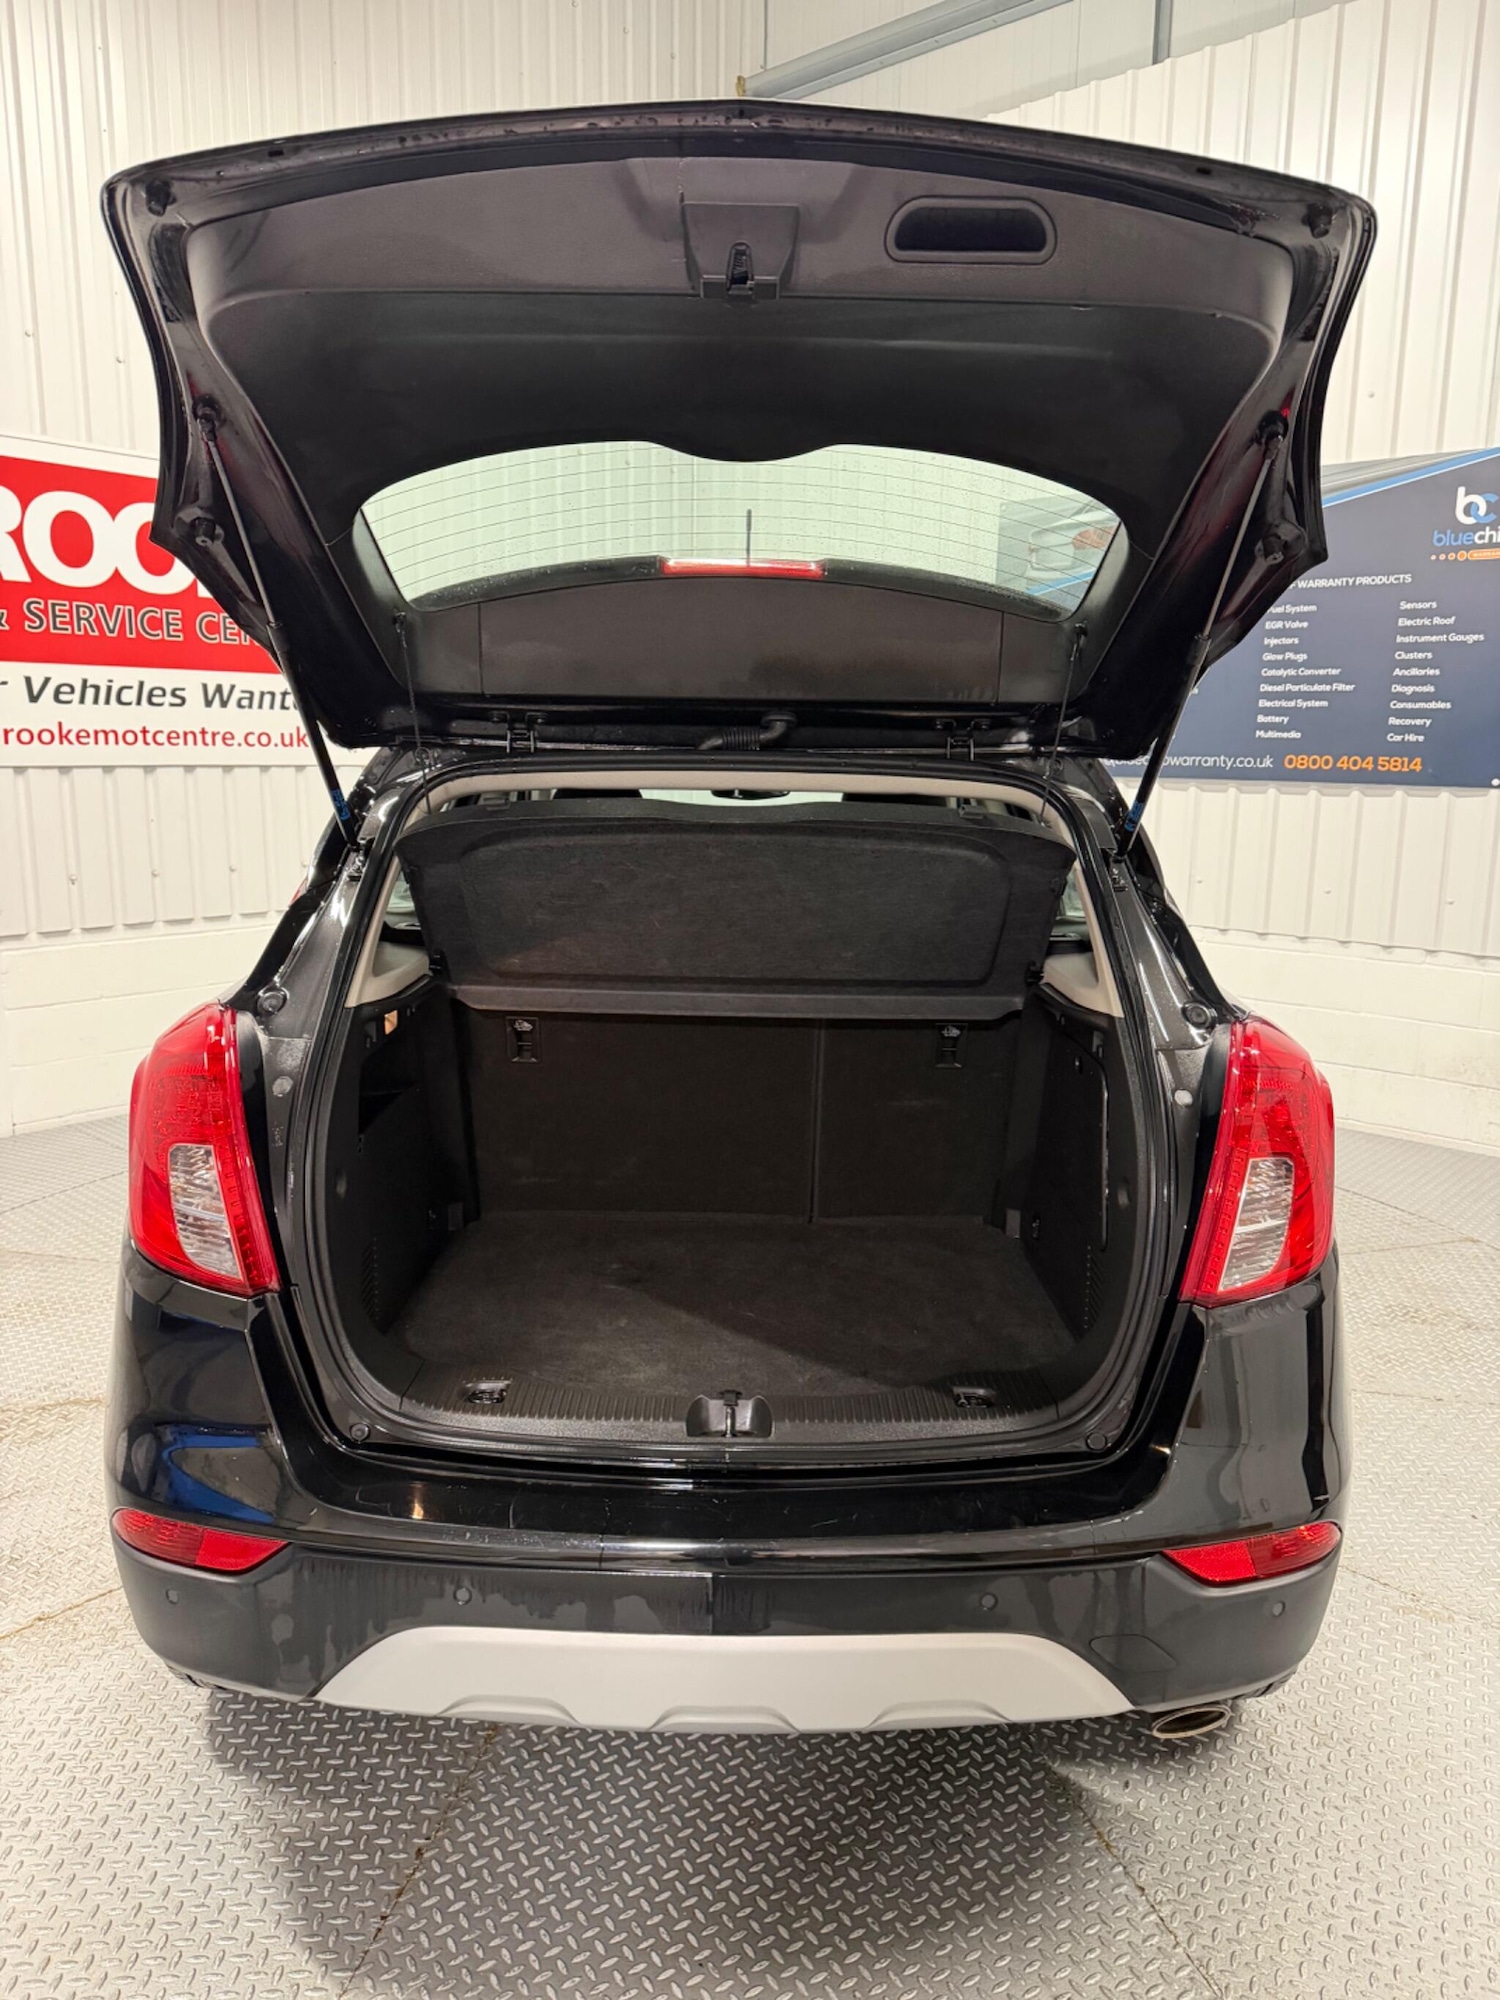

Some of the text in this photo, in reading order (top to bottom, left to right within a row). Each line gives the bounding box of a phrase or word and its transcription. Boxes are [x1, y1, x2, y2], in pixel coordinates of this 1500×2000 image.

[1298, 577, 1355, 589] WARRANTY
[1355, 574, 1412, 586] PRODUCTS
[1285, 603, 1317, 615] System
[1399, 600, 1437, 610] Sensors
[23, 597, 184, 642] SERVICE
[1265, 620, 1309, 630] EGR Valve
[1397, 616, 1456, 627] Electric Roof
[1263, 636, 1299, 648] Injectors
[1396, 632, 1485, 644] Instrument Gauges
[1262, 651, 1308, 662] Glow Plugs
[1394, 651, 1433, 660] Clusters
[1261, 667, 1341, 678] Catalytic Converter
[1392, 667, 1440, 677] Ancillaries
[1259, 682, 1355, 692] Diesel Particulate Filter
[1391, 683, 1435, 695] Diagnosis
[23, 675, 299, 711] Vehicles Want
[1258, 699, 1329, 709] Electrical System
[1390, 700, 1452, 709] Consumables
[1257, 714, 1289, 725] Battery
[1388, 716, 1432, 728] Recovery
[2, 721, 309, 748] rookemotcentre.co.uk
[1255, 730, 1301, 739] Multimedia
[1386, 732, 1425, 742] Car Hire
[1284, 755, 1333, 770] 0800
[1336, 755, 1374, 771] 404
[1377, 756, 1422, 772] 5814
